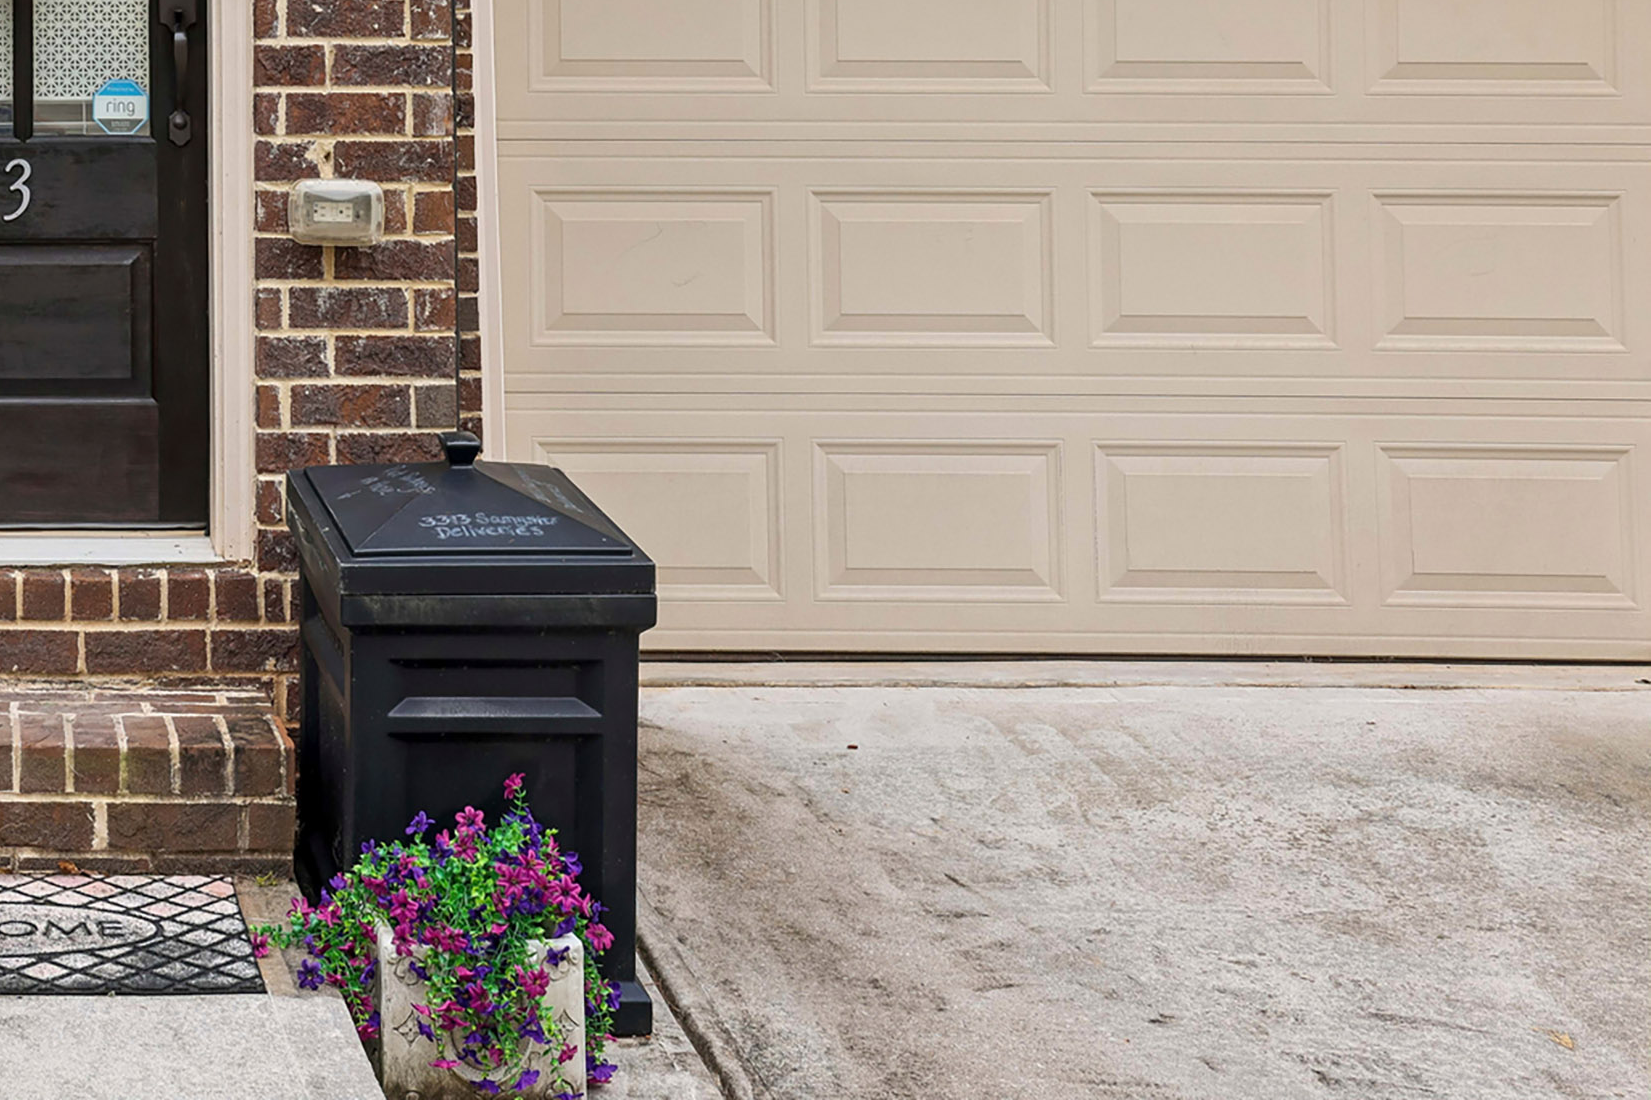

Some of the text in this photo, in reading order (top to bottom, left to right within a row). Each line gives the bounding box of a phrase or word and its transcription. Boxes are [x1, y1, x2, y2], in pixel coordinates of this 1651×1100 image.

[106, 98, 136, 117] ring
[418, 513, 472, 528] 3313
[435, 525, 545, 540] Deliveries
